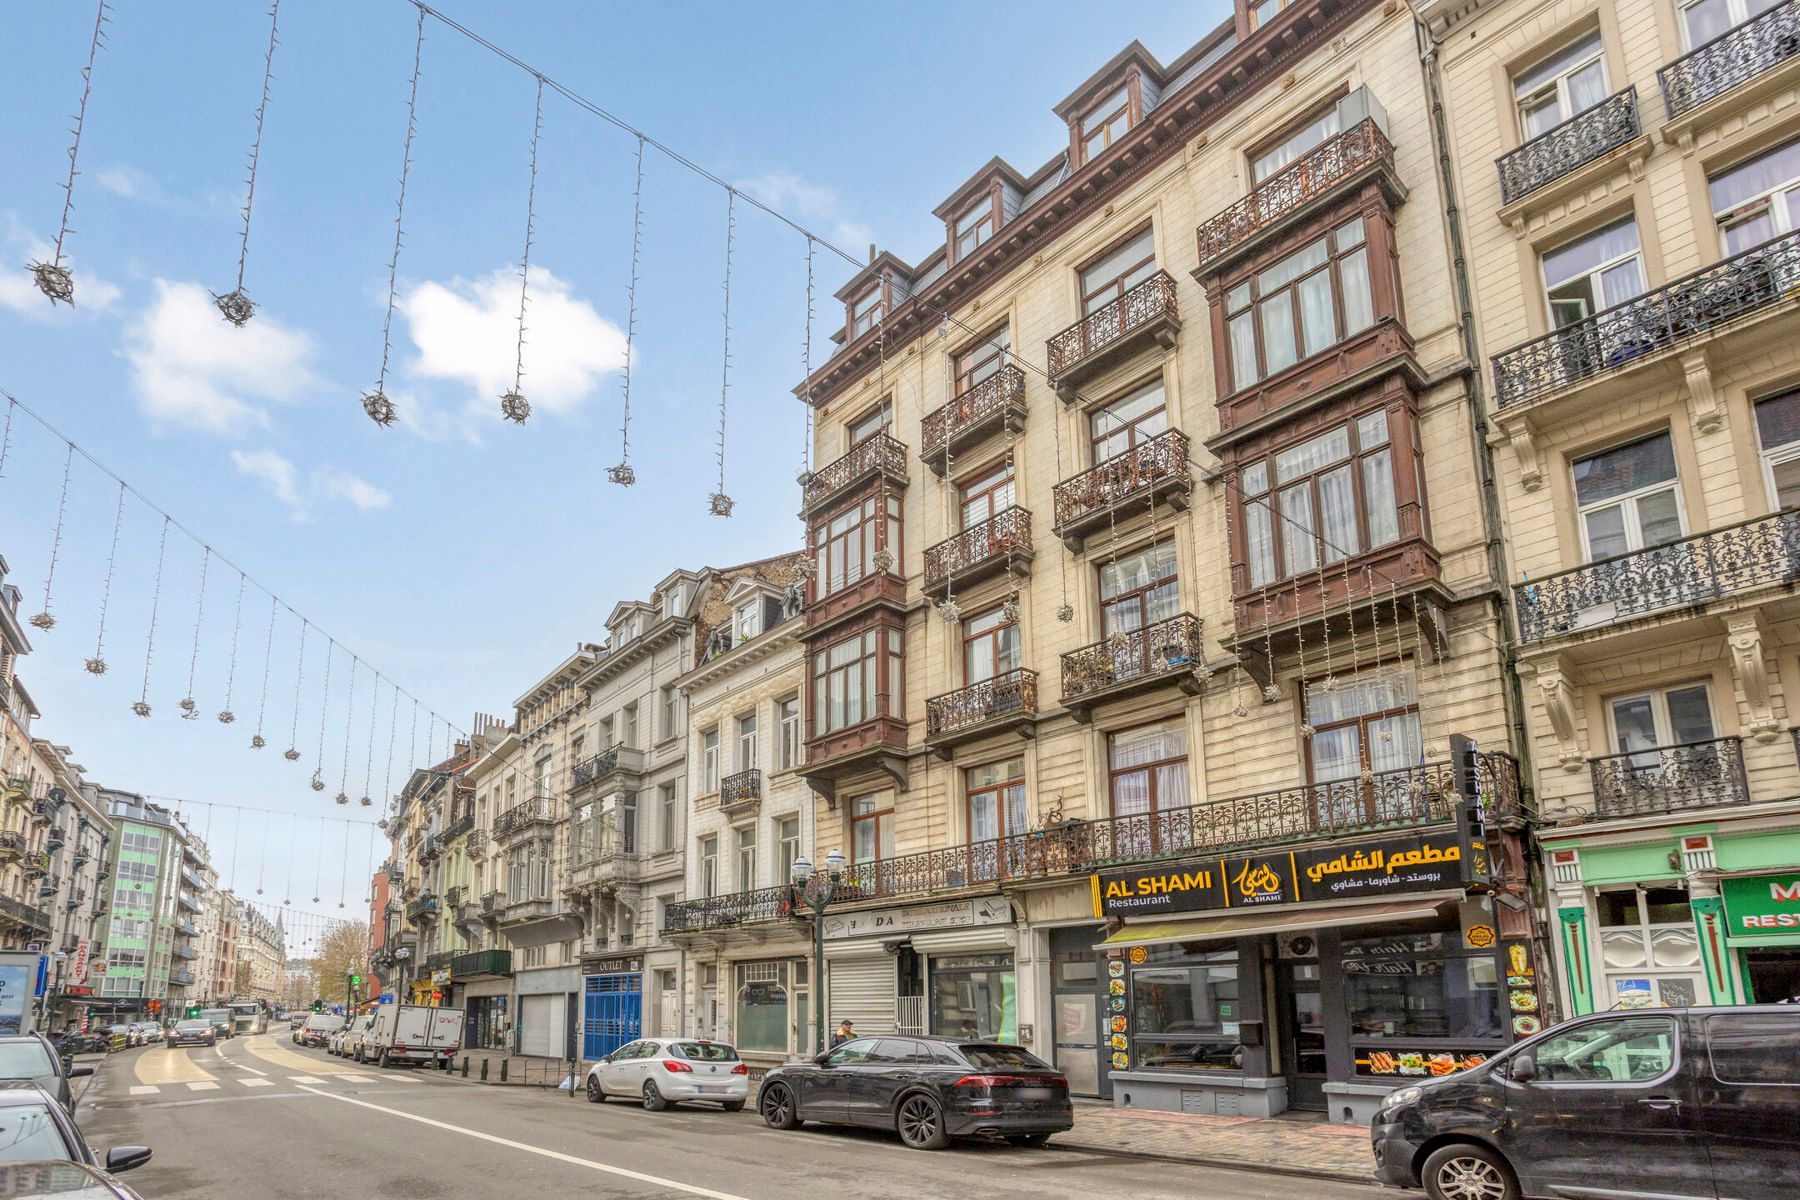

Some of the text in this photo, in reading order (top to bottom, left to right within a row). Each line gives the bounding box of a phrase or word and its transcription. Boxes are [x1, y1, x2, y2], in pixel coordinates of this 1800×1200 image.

[1474, 767, 1486, 837] SHAMI
[1306, 844, 1461, 882] مطعم الشامي
[1106, 871, 1212, 898] AL SHAMI
[1330, 871, 1441, 892] بروستد شاورما مشاوي
[1109, 895, 1171, 908] Restaurant
[1255, 895, 1281, 903] SHAMI
[600, 960, 623, 971] OUTLET
